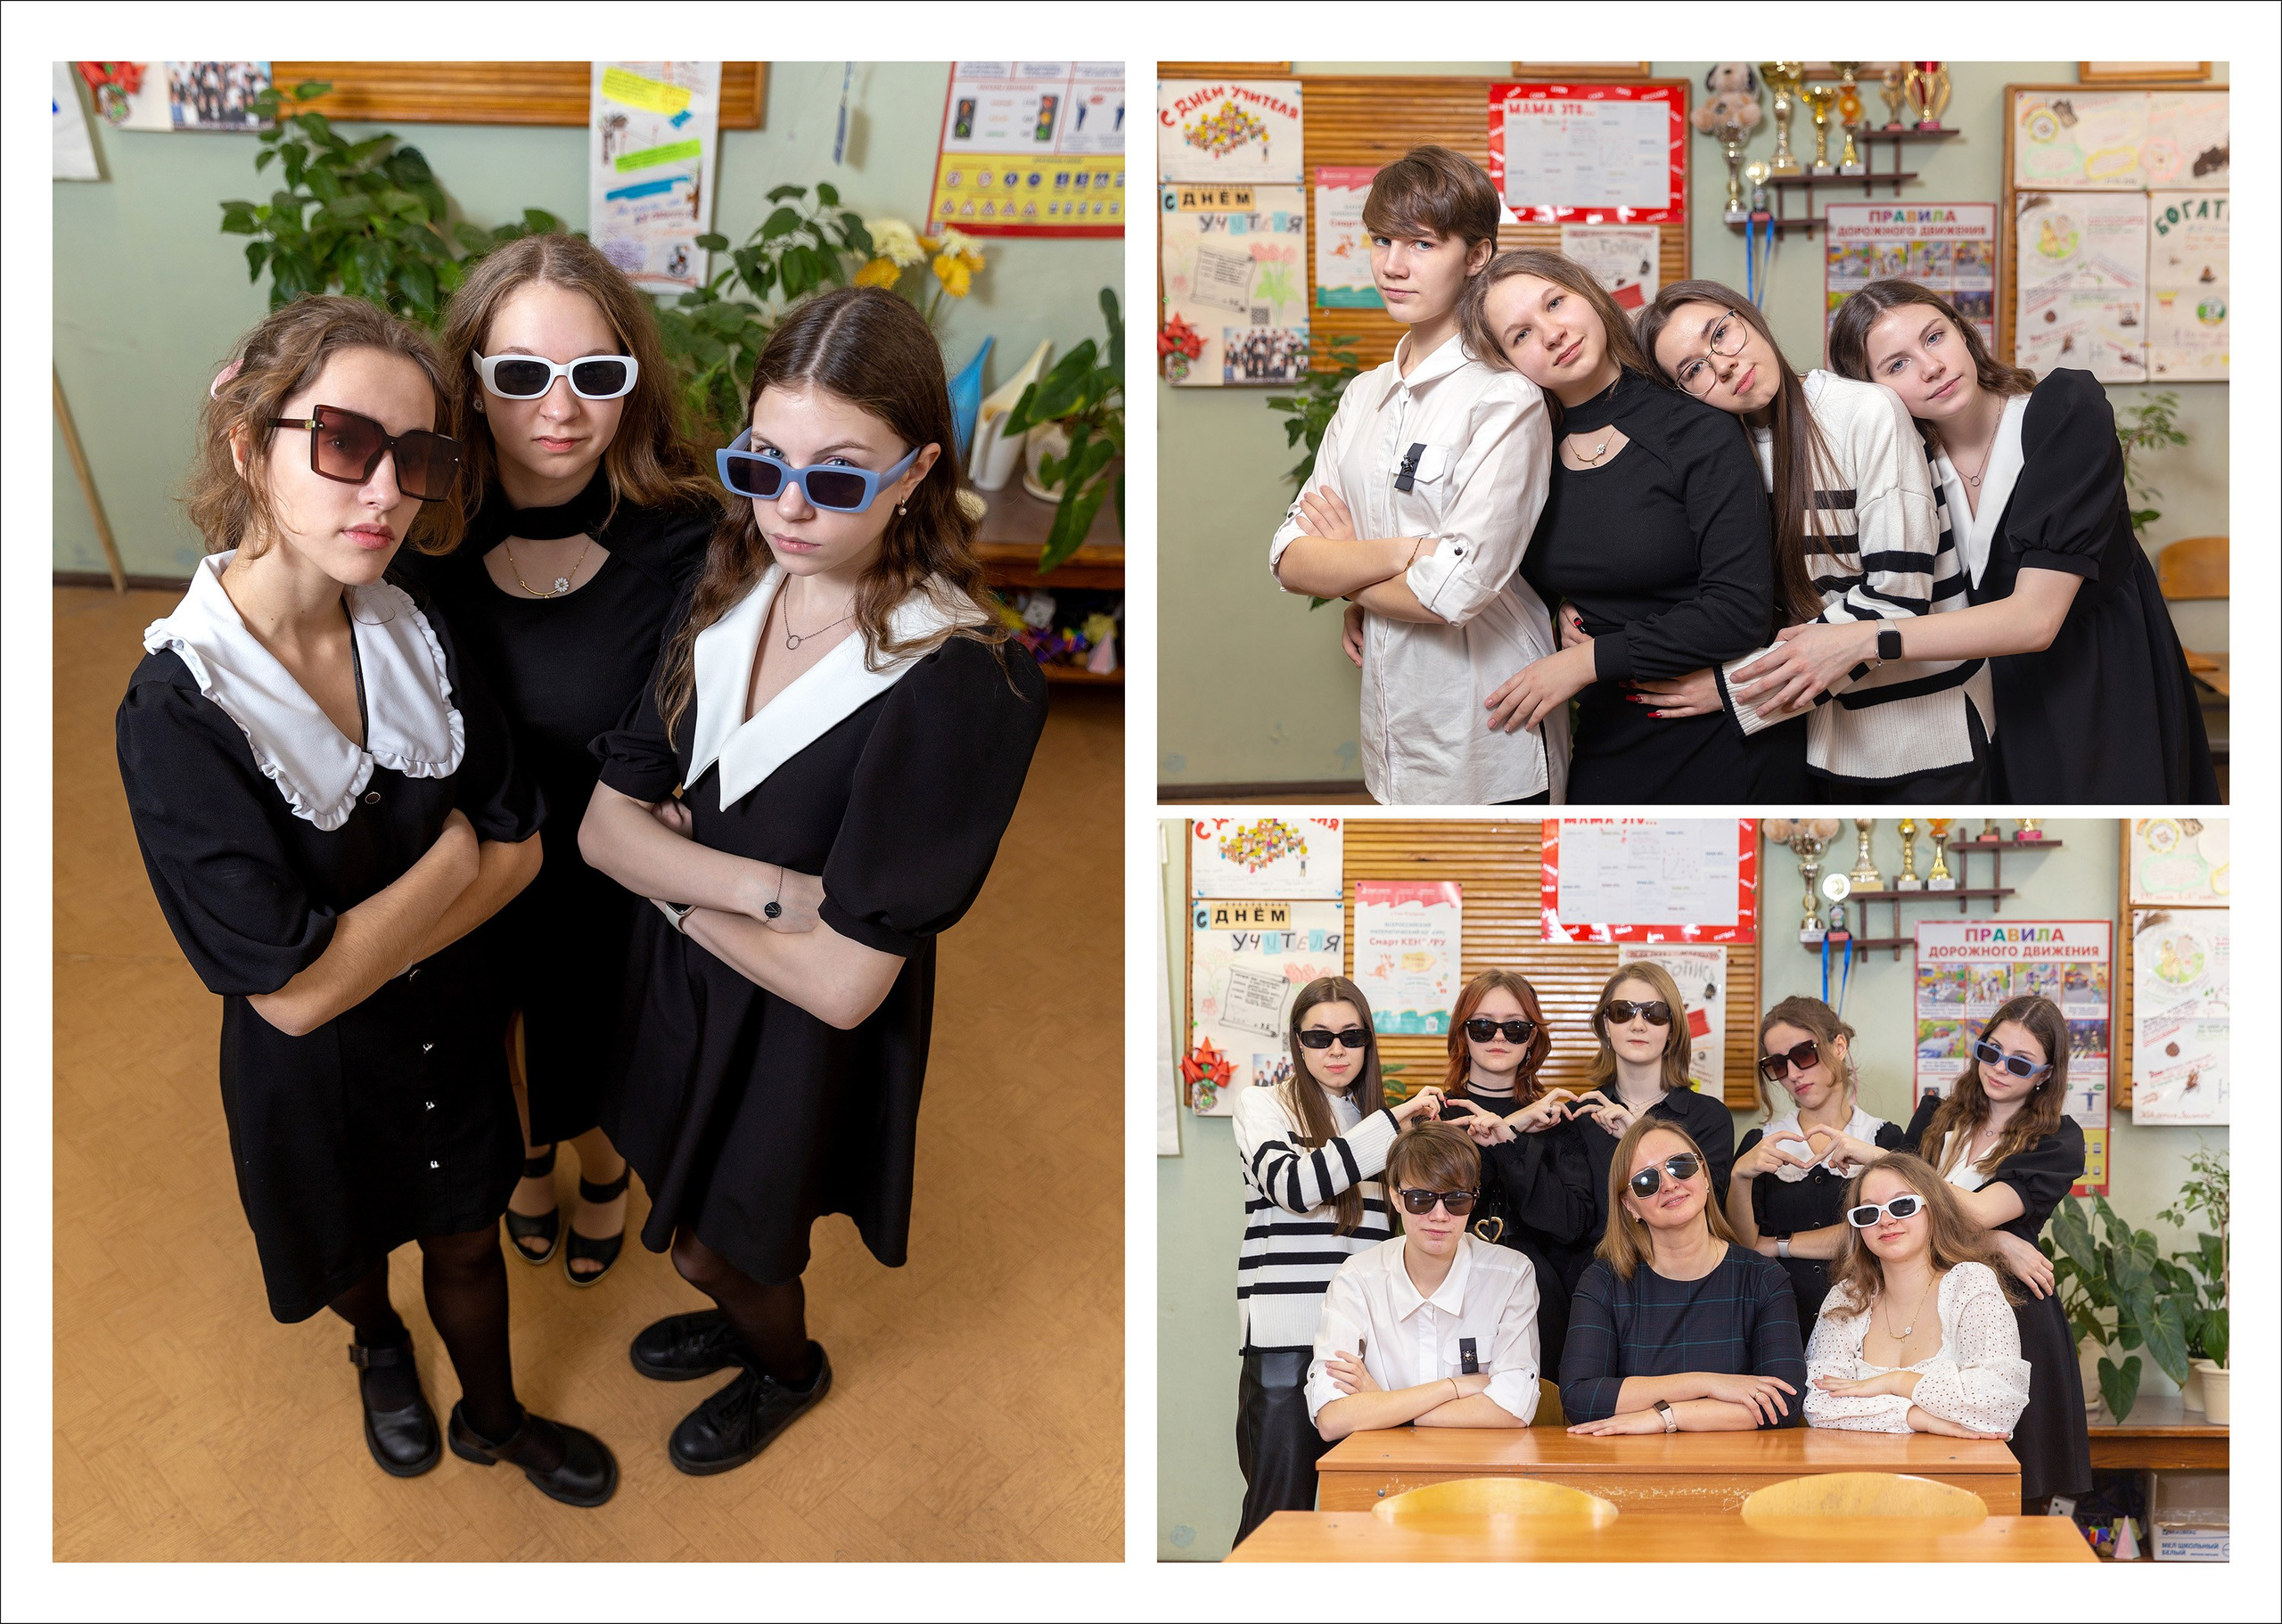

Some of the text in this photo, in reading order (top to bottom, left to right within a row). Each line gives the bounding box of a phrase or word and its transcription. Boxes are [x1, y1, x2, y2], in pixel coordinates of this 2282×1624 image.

[1161, 111, 1175, 126] С
[1231, 86, 1299, 119] УЧИТЕЛЯ
[1508, 103, 1554, 114] МАМА
[1164, 188, 1250, 209] С ДНЁМ
[1869, 209, 1957, 222] ПРАВИЛА
[2155, 199, 2229, 235] БОГАТ
[1837, 226, 1986, 237] ДОРОЖНОГО ДВИЖЕНИЯ
[1196, 906, 1285, 928] С ДНЁМ
[1233, 932, 1341, 952] УЧИТЕЛЯ
[1965, 928, 2065, 942] ПРАВИЛА
[1369, 938, 1399, 947] Смарт
[1928, 946, 2099, 958] ДОРОЖНОГО ДВИЖЕНИЯ
